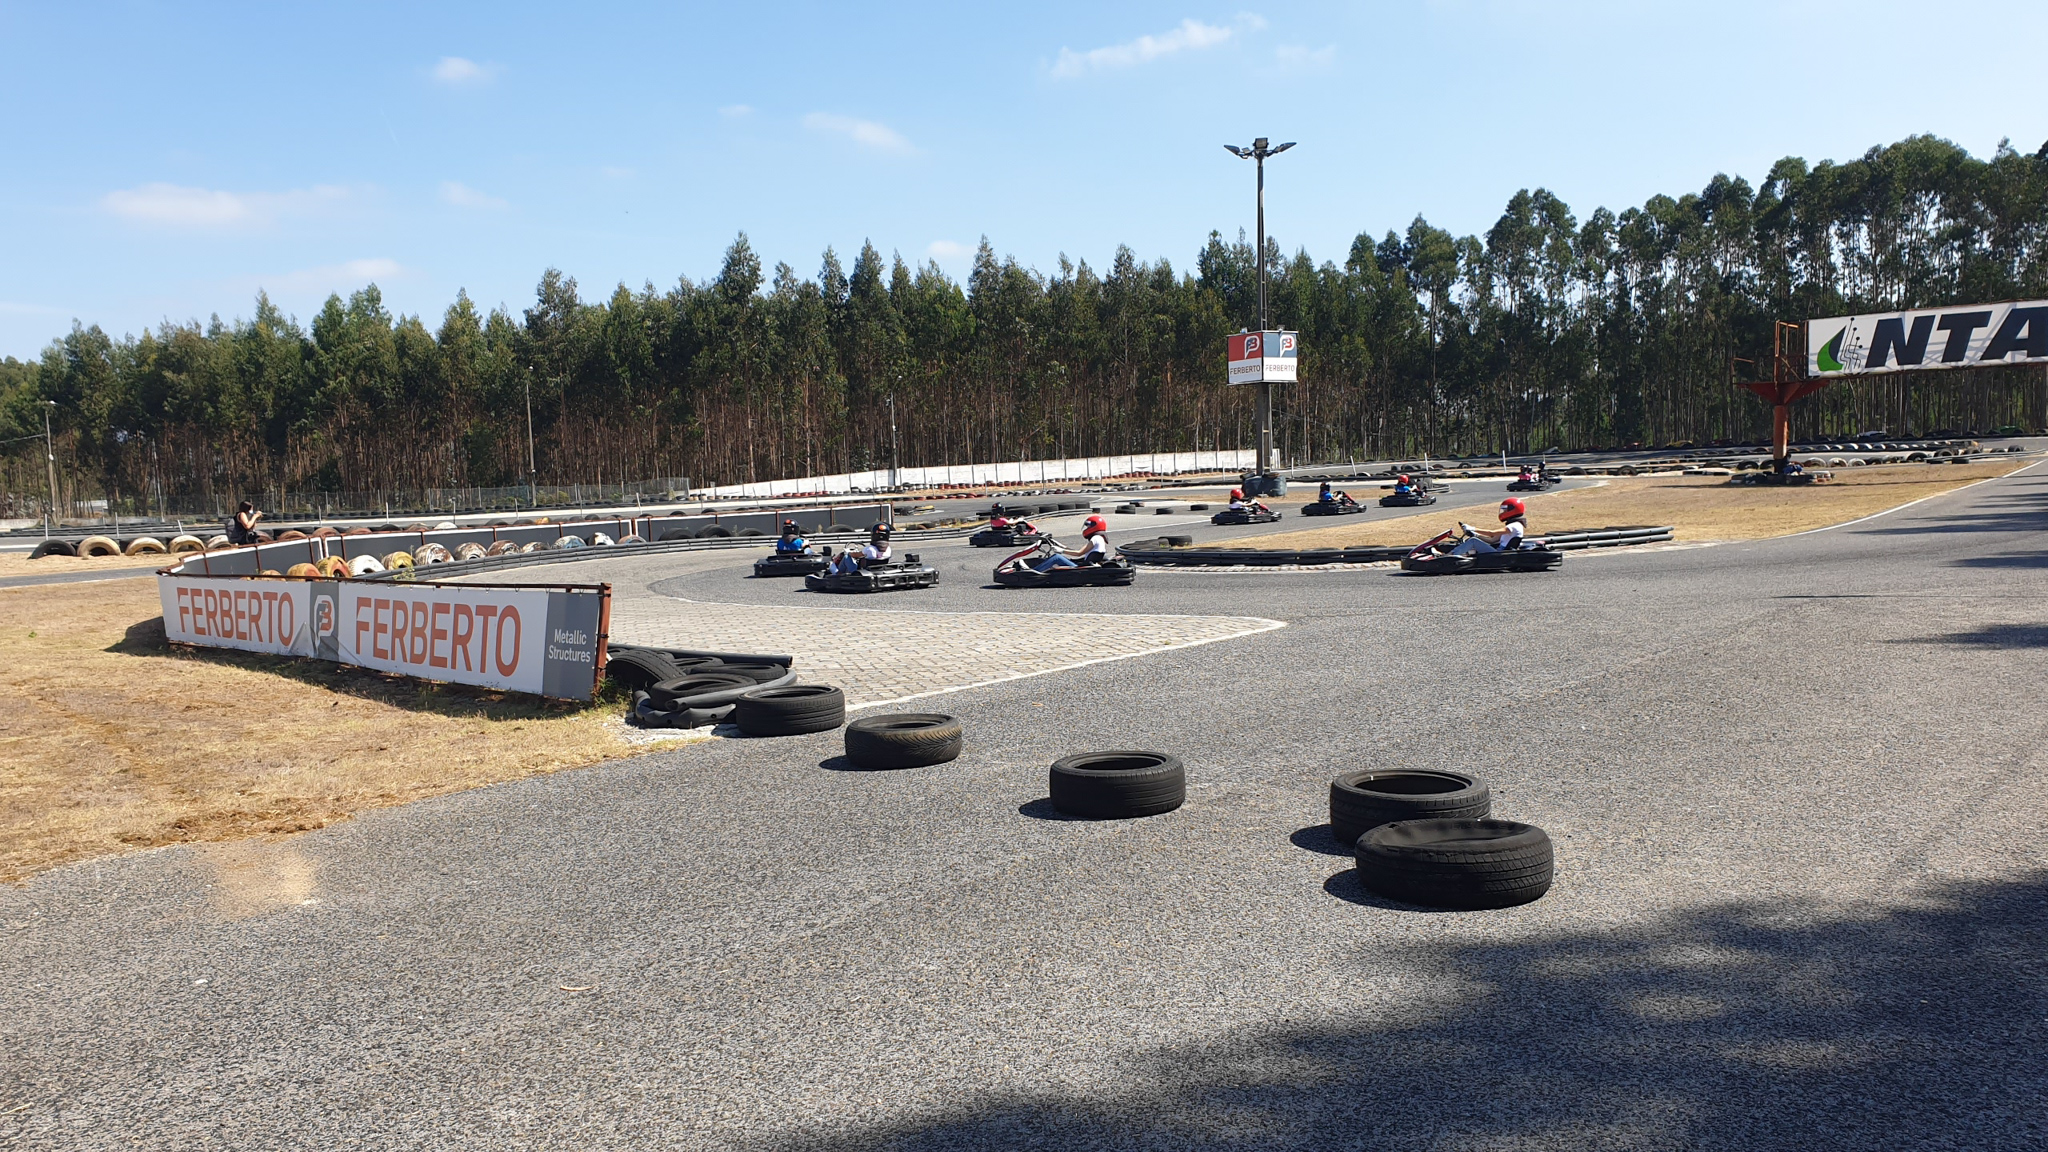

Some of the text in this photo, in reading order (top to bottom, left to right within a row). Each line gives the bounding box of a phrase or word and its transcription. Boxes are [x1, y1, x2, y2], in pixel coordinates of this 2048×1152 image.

[1230, 365, 1260, 375] FERBERTO
[1265, 364, 1295, 372] FERBERTO
[177, 588, 293, 647] FERBERTO
[356, 597, 521, 677] FERBERTO
[554, 628, 587, 645] Metallic
[548, 645, 591, 663] Structures
